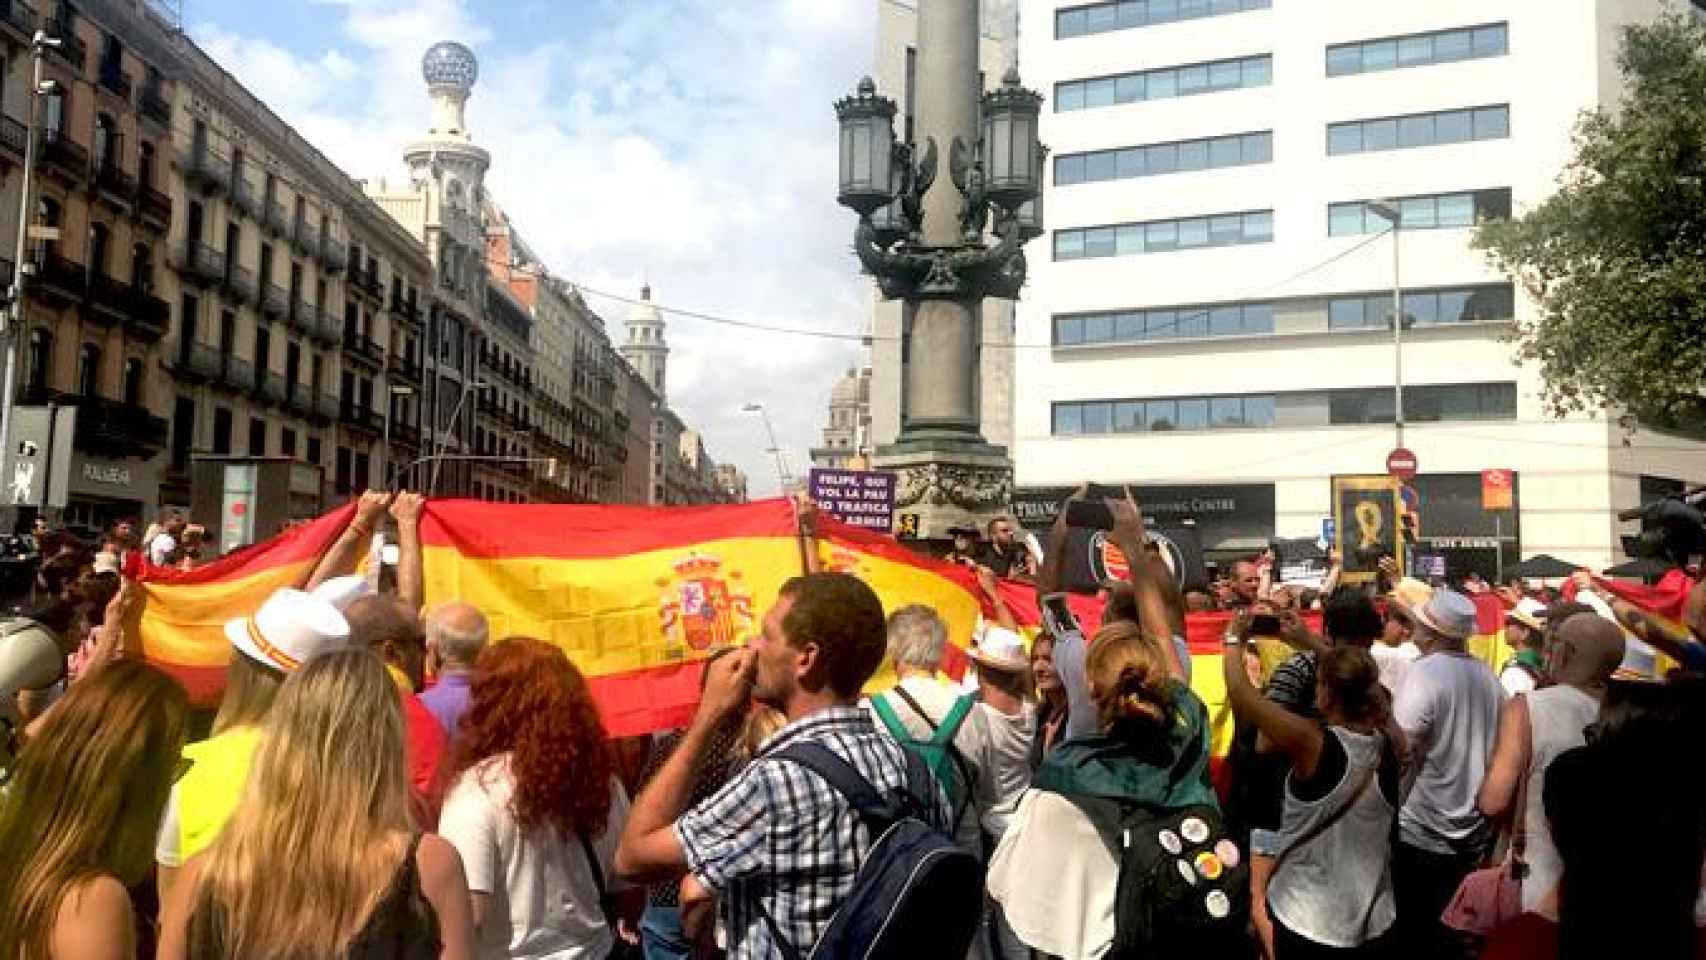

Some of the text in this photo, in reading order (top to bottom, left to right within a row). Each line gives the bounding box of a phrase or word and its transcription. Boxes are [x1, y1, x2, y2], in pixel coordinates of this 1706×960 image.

[818, 473, 888, 487] FELIPE, QUI
[818, 487, 888, 500] VOL LA PAU
[838, 501, 890, 513] TRAFICA
